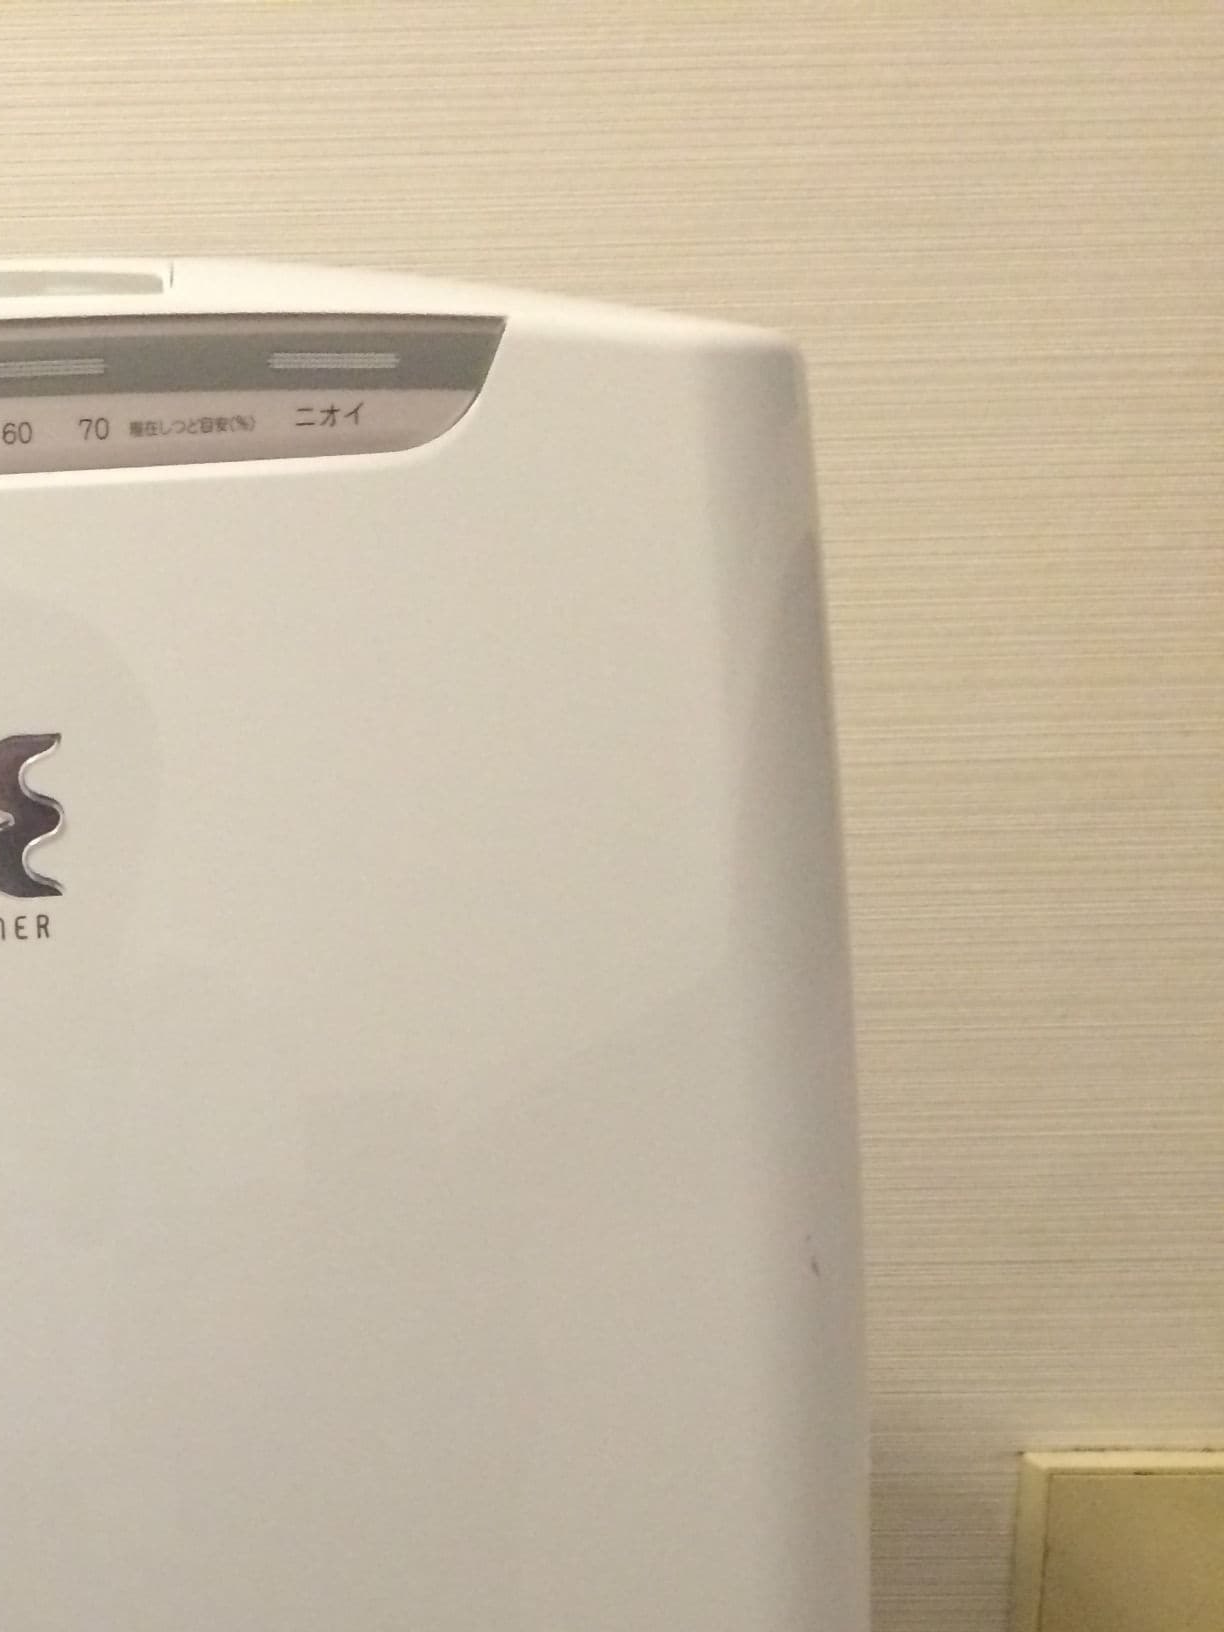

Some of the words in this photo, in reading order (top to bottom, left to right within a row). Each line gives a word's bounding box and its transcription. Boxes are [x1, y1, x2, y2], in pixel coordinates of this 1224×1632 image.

[295, 402, 365, 428] ニオイ
[2, 421, 33, 445] 60
[78, 417, 110, 441] 70
